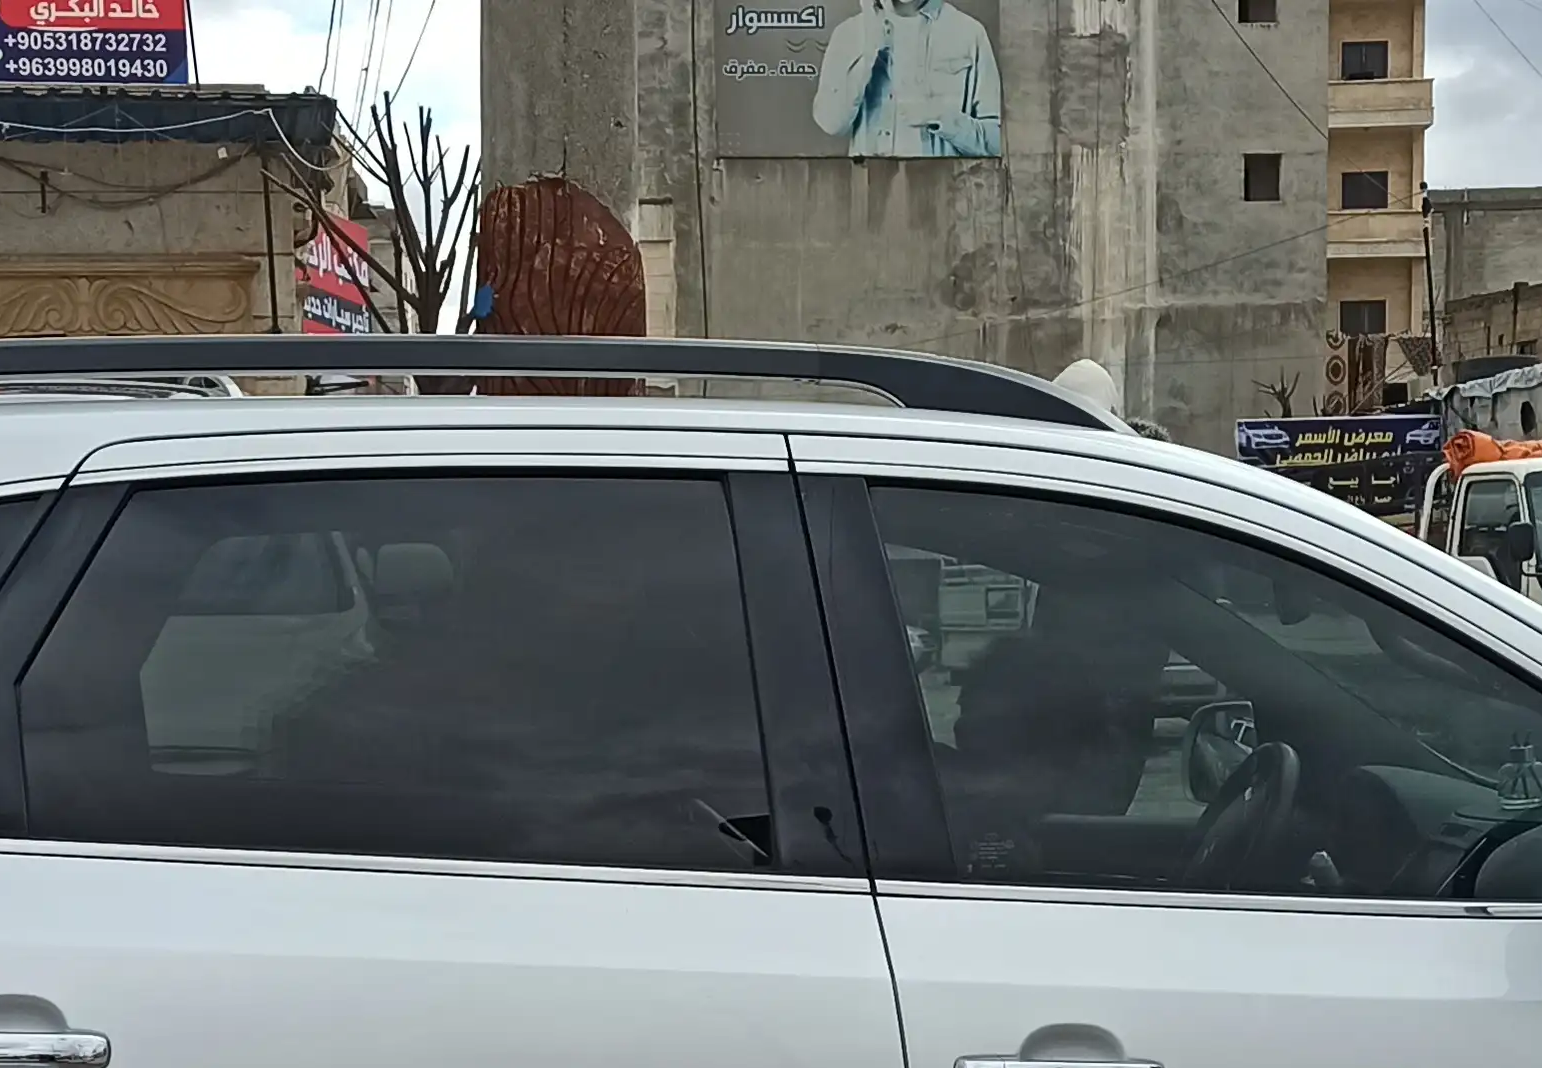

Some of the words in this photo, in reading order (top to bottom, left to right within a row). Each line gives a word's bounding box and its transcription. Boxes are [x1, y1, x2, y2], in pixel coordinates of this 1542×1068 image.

[29, 0, 104, 25] البكري
[109, 0, 160, 18] خالد
[725, 6, 824, 35] اكسسوار
[4, 31, 167, 52] +905318732732
[5, 57, 168, 77] +963998019430
[723, 59, 767, 80] مفرق
[779, 60, 818, 79] جملة
[1343, 428, 1394, 447] معرض
